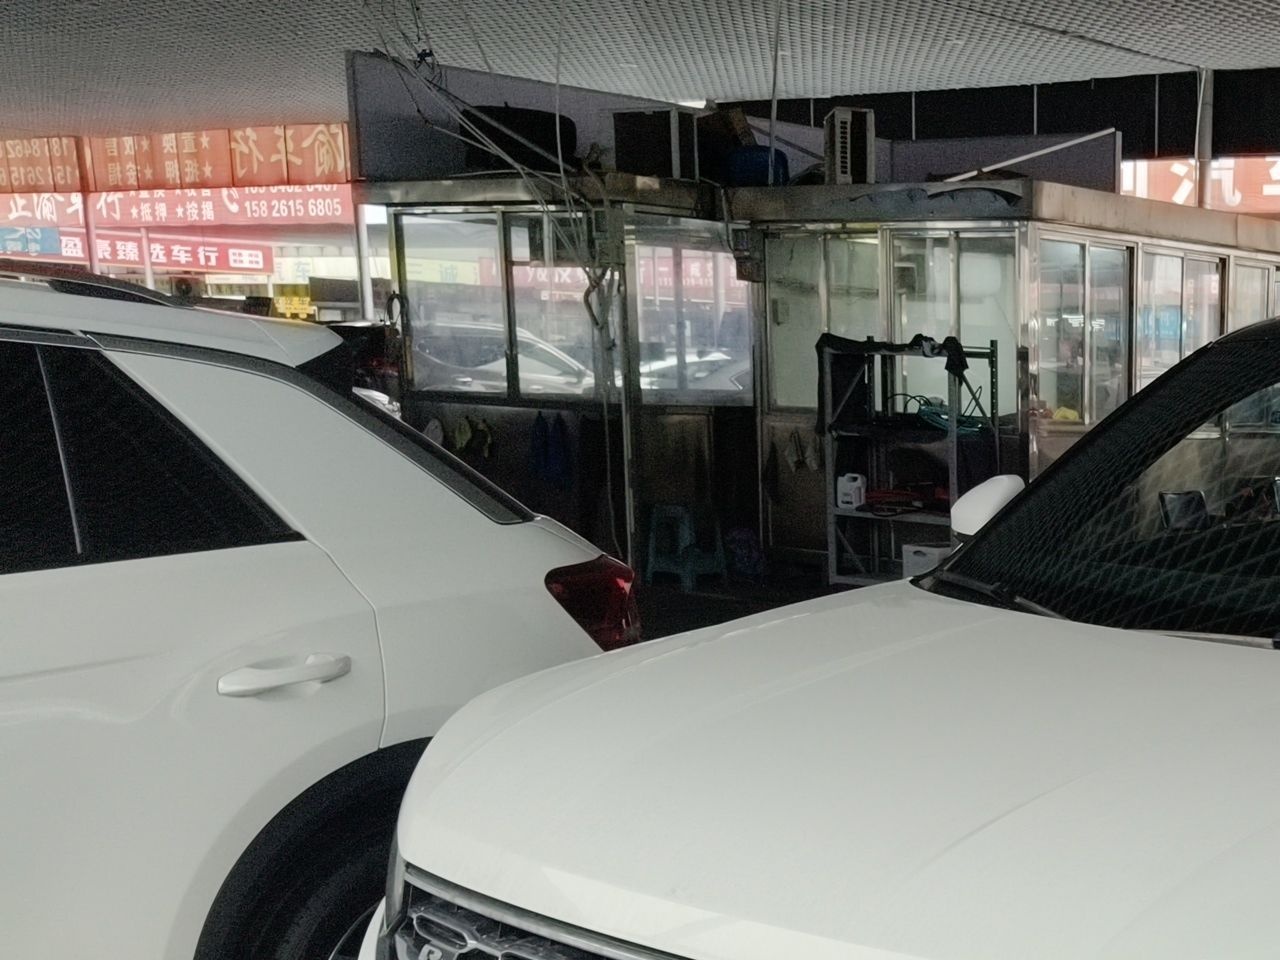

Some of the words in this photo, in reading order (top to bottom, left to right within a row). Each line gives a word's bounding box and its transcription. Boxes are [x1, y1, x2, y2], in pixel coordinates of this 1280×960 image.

[140, 202, 168, 222] 抵押
[186, 201, 215, 221] 按揭
[244, 200, 268, 218] 158
[271, 199, 305, 218] 2615
[308, 198, 342, 217] 6805
